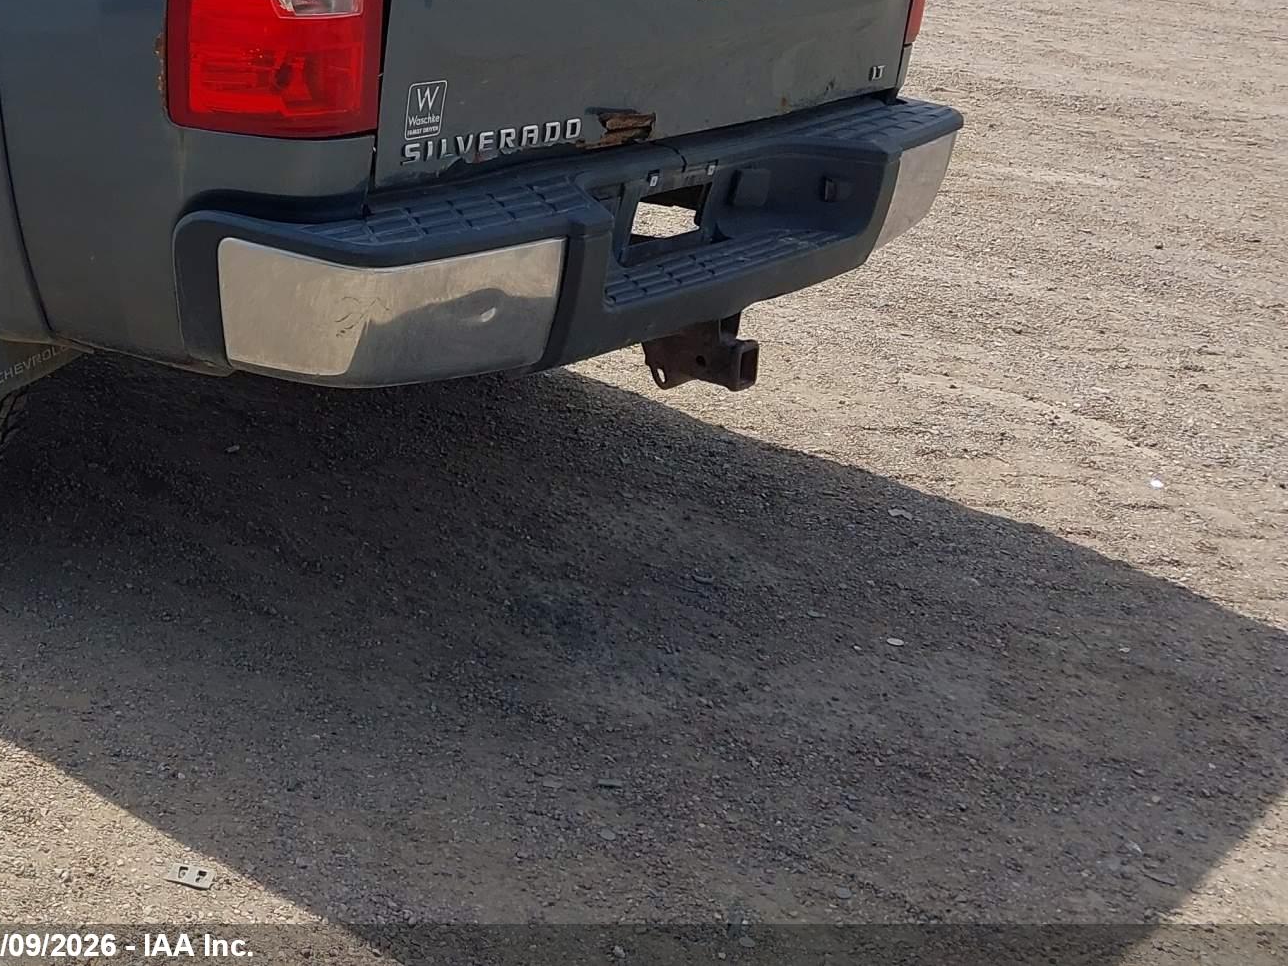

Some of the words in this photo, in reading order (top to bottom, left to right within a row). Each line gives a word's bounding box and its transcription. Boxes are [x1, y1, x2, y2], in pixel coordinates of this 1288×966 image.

[417, 86, 440, 112] W
[408, 113, 440, 127] Waschke
[403, 118, 582, 164] SILVERADO
